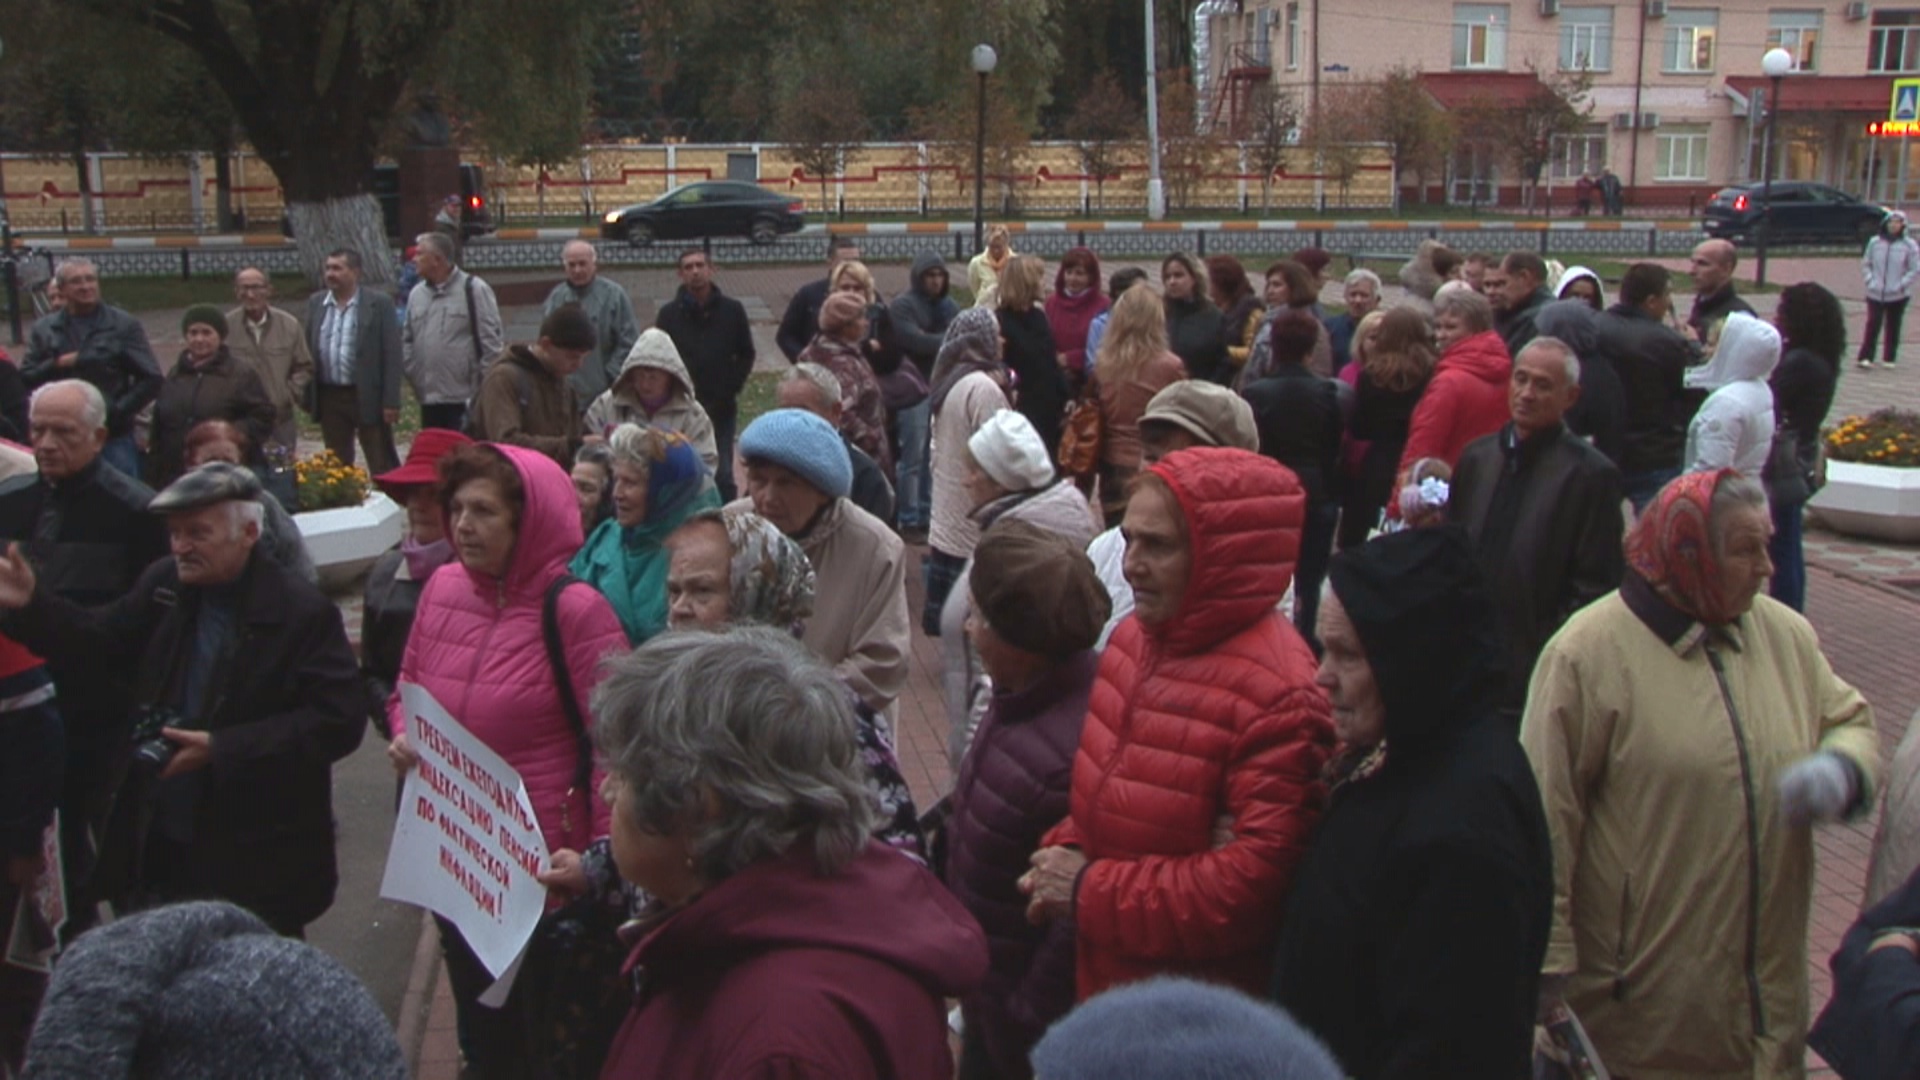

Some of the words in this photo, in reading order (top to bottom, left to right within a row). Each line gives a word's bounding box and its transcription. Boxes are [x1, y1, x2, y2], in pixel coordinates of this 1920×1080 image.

[415, 714, 462, 772] ТРЕБУЕМ
[417, 755, 493, 836] ИНДЕКСАЦИЮ
[417, 795, 436, 823] ПО
[440, 812, 510, 891] ФАКТИЧЕСКОЙ
